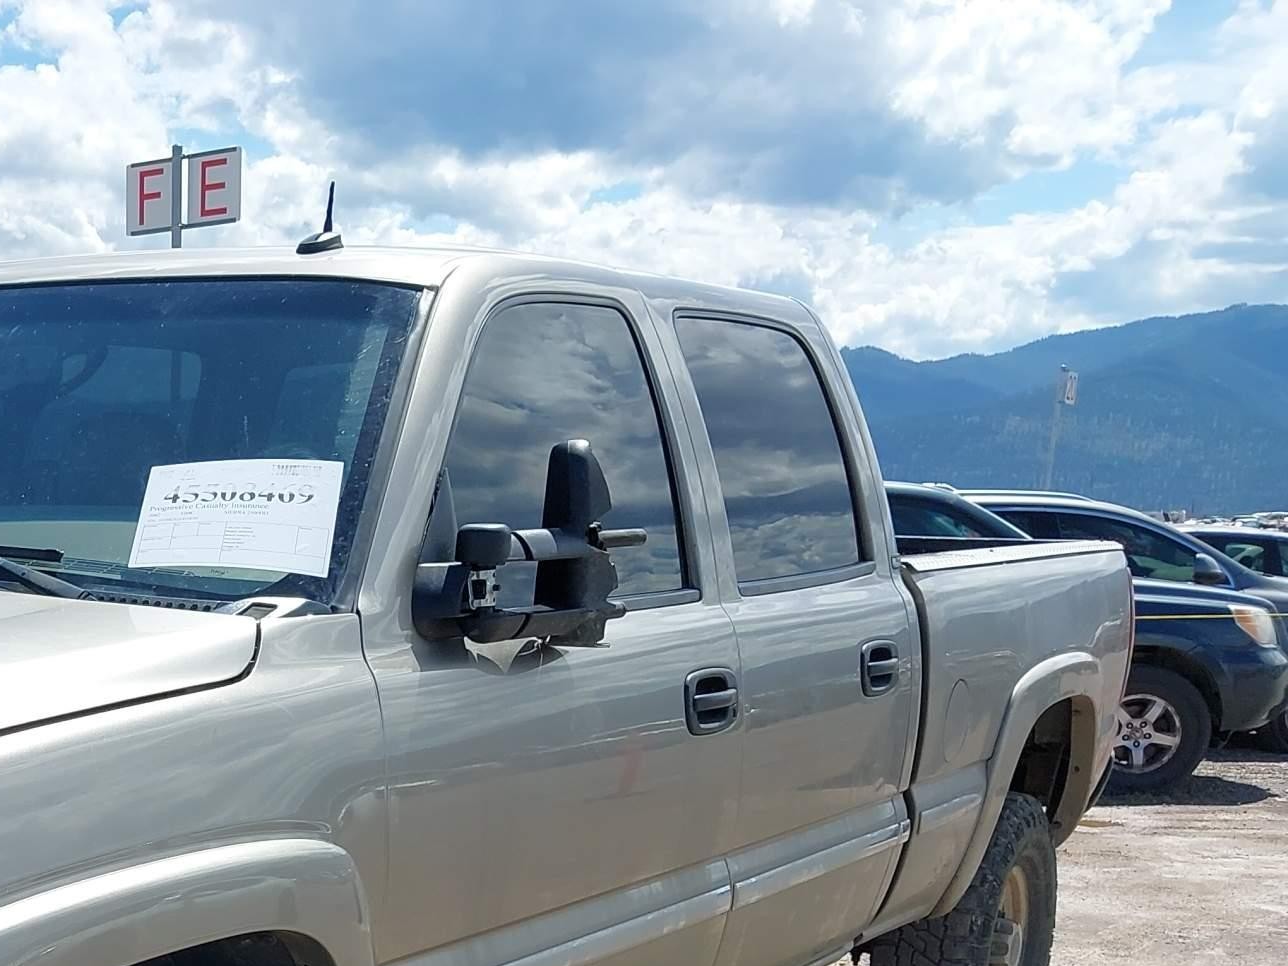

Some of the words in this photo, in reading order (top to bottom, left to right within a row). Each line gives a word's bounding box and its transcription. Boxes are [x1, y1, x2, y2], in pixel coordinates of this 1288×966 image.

[139, 168, 164, 226] F
[200, 158, 228, 217] E
[150, 503, 193, 513] Progressive
[195, 502, 229, 511] Casualty
[231, 502, 270, 510] Insurance
[164, 483, 314, 504] 45508469
